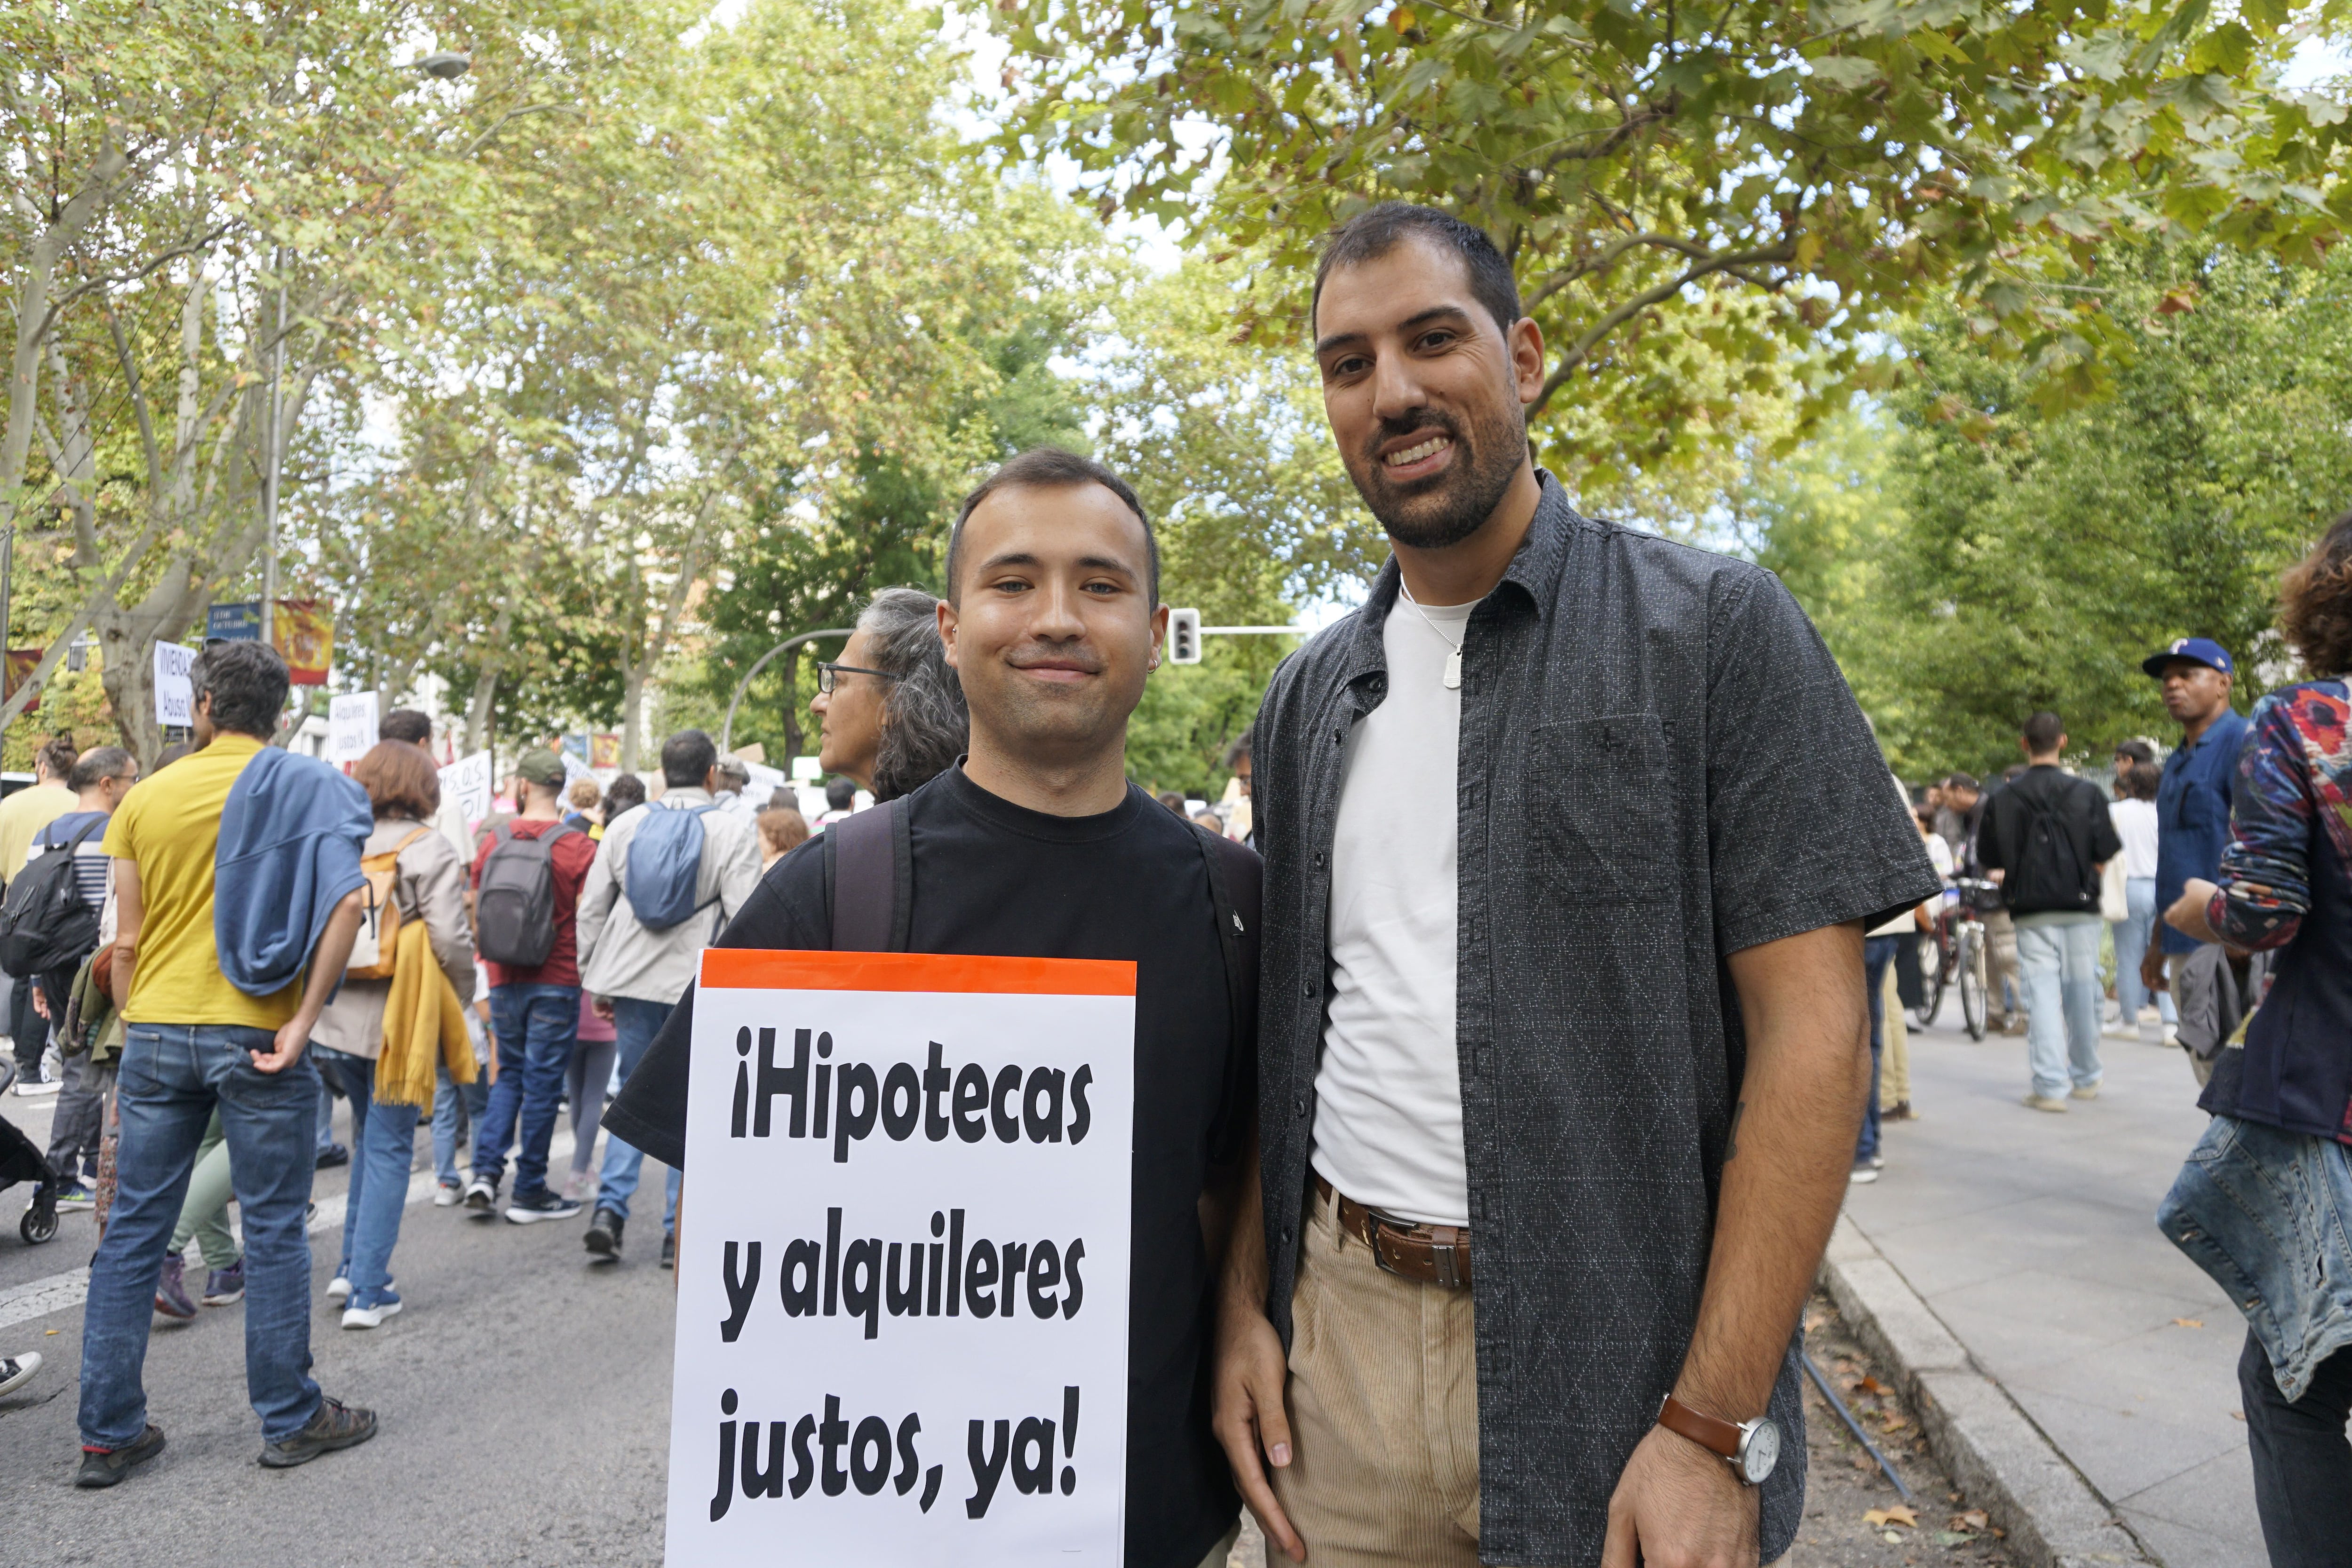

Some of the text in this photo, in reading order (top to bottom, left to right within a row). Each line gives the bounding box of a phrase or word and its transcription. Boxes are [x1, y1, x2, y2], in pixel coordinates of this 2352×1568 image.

[731, 1026, 1093, 1163] ¡Hipotecas
[721, 1207, 1085, 1343] y alquileres
[710, 1385, 1080, 1522] justos, ya!
